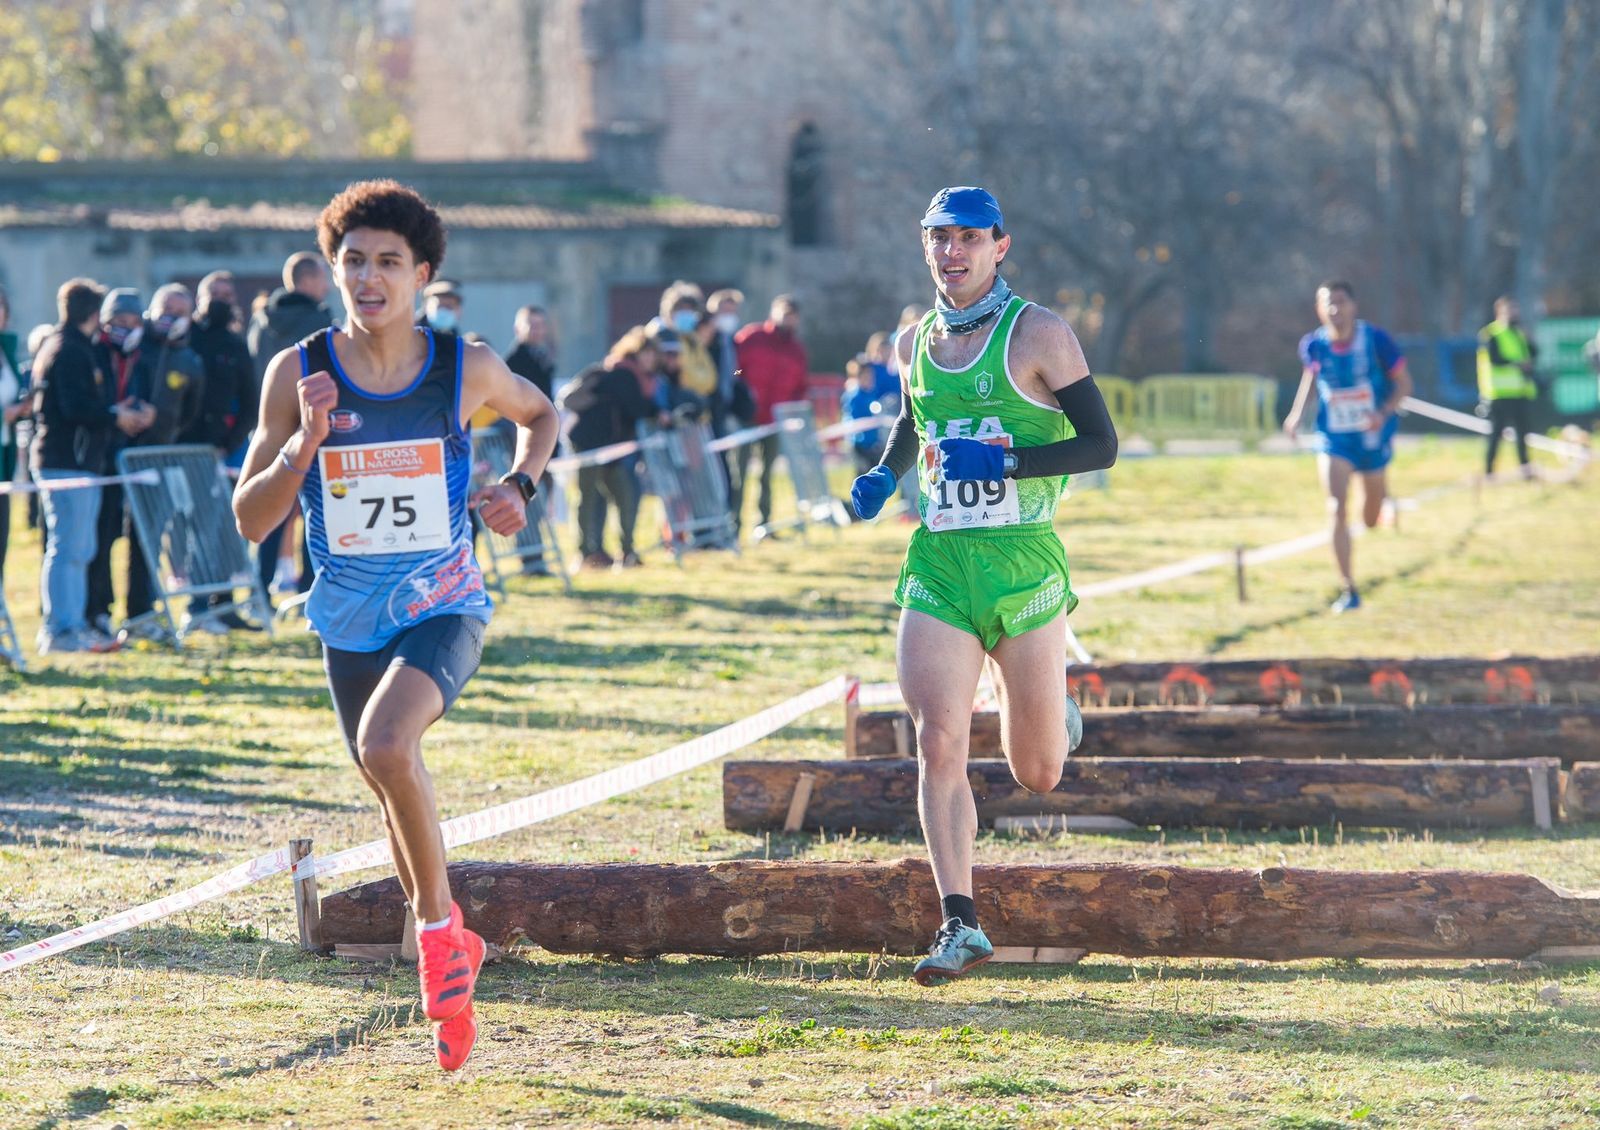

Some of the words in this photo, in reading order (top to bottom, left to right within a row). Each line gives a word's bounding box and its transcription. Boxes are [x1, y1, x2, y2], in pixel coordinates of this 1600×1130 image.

[341, 450, 365, 471] III
[367, 457, 425, 469] NACIONAL
[374, 446, 418, 460] CROSS
[937, 480, 1006, 510] 109
[360, 495, 417, 530] 75
